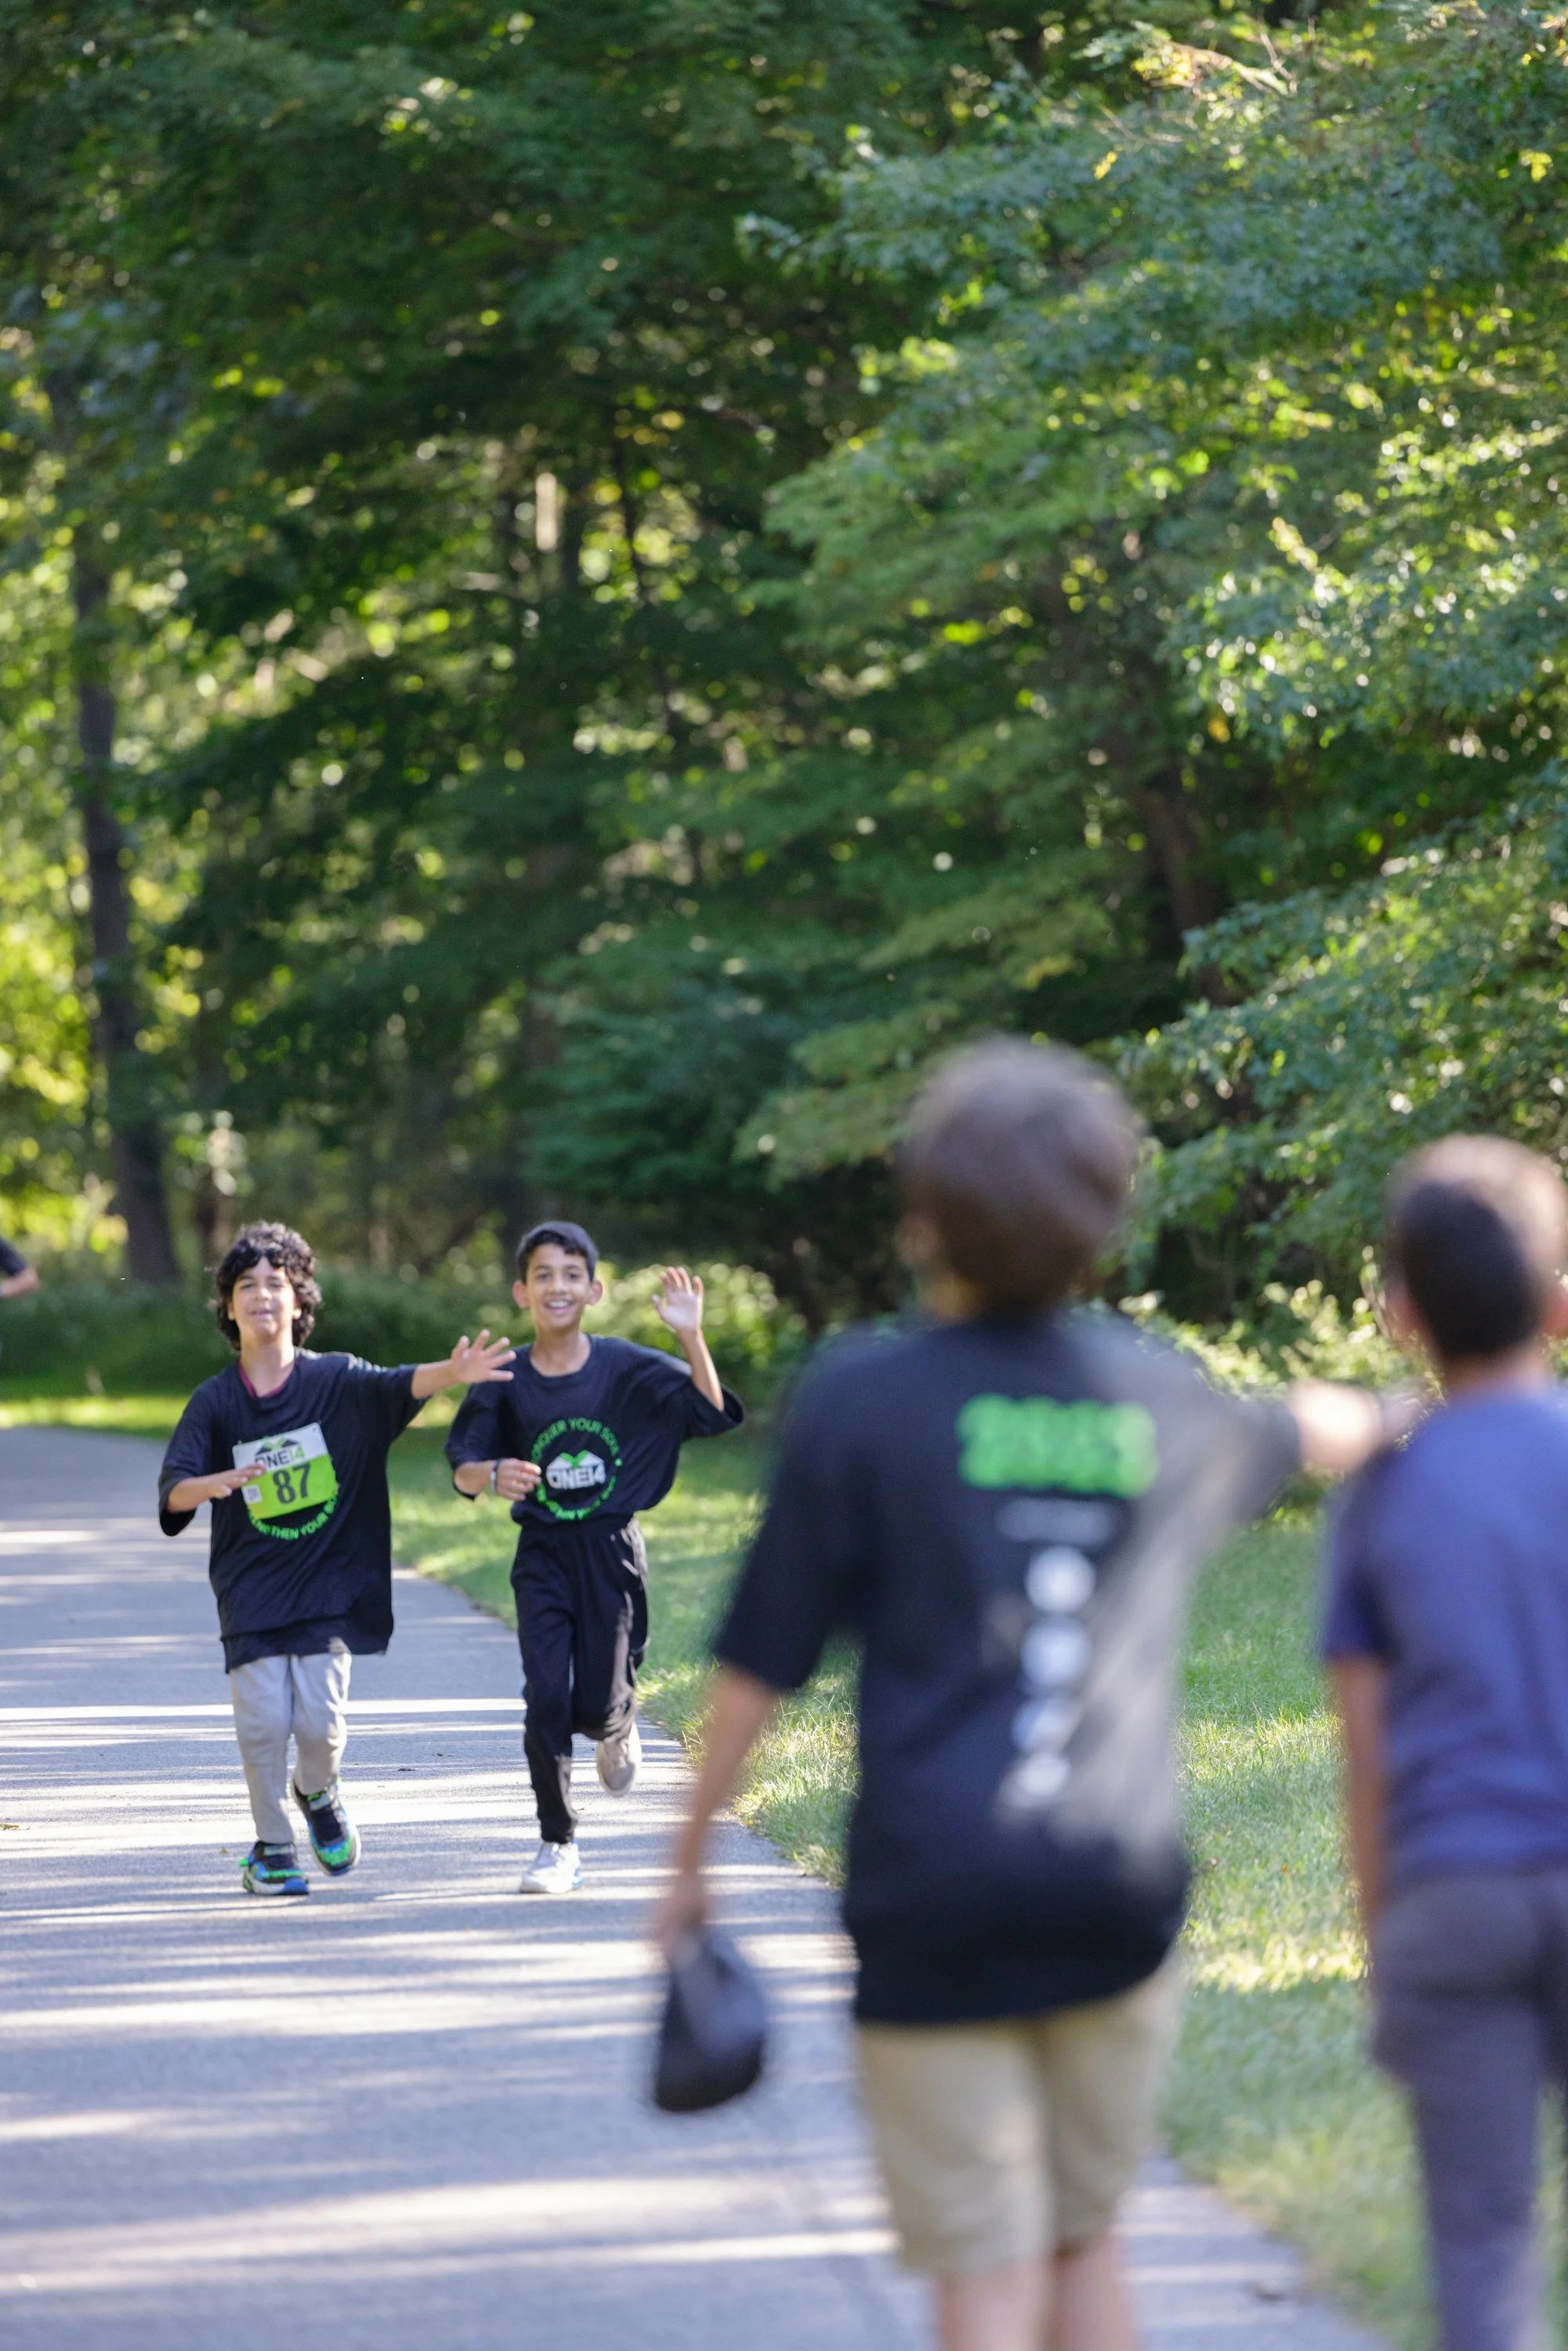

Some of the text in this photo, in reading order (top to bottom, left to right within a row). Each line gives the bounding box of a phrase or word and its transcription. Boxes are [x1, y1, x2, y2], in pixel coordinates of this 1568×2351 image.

[568, 1417, 603, 1434] YOUR
[273, 1462, 310, 1504] 87
[300, 1512, 328, 1536] YOUR
